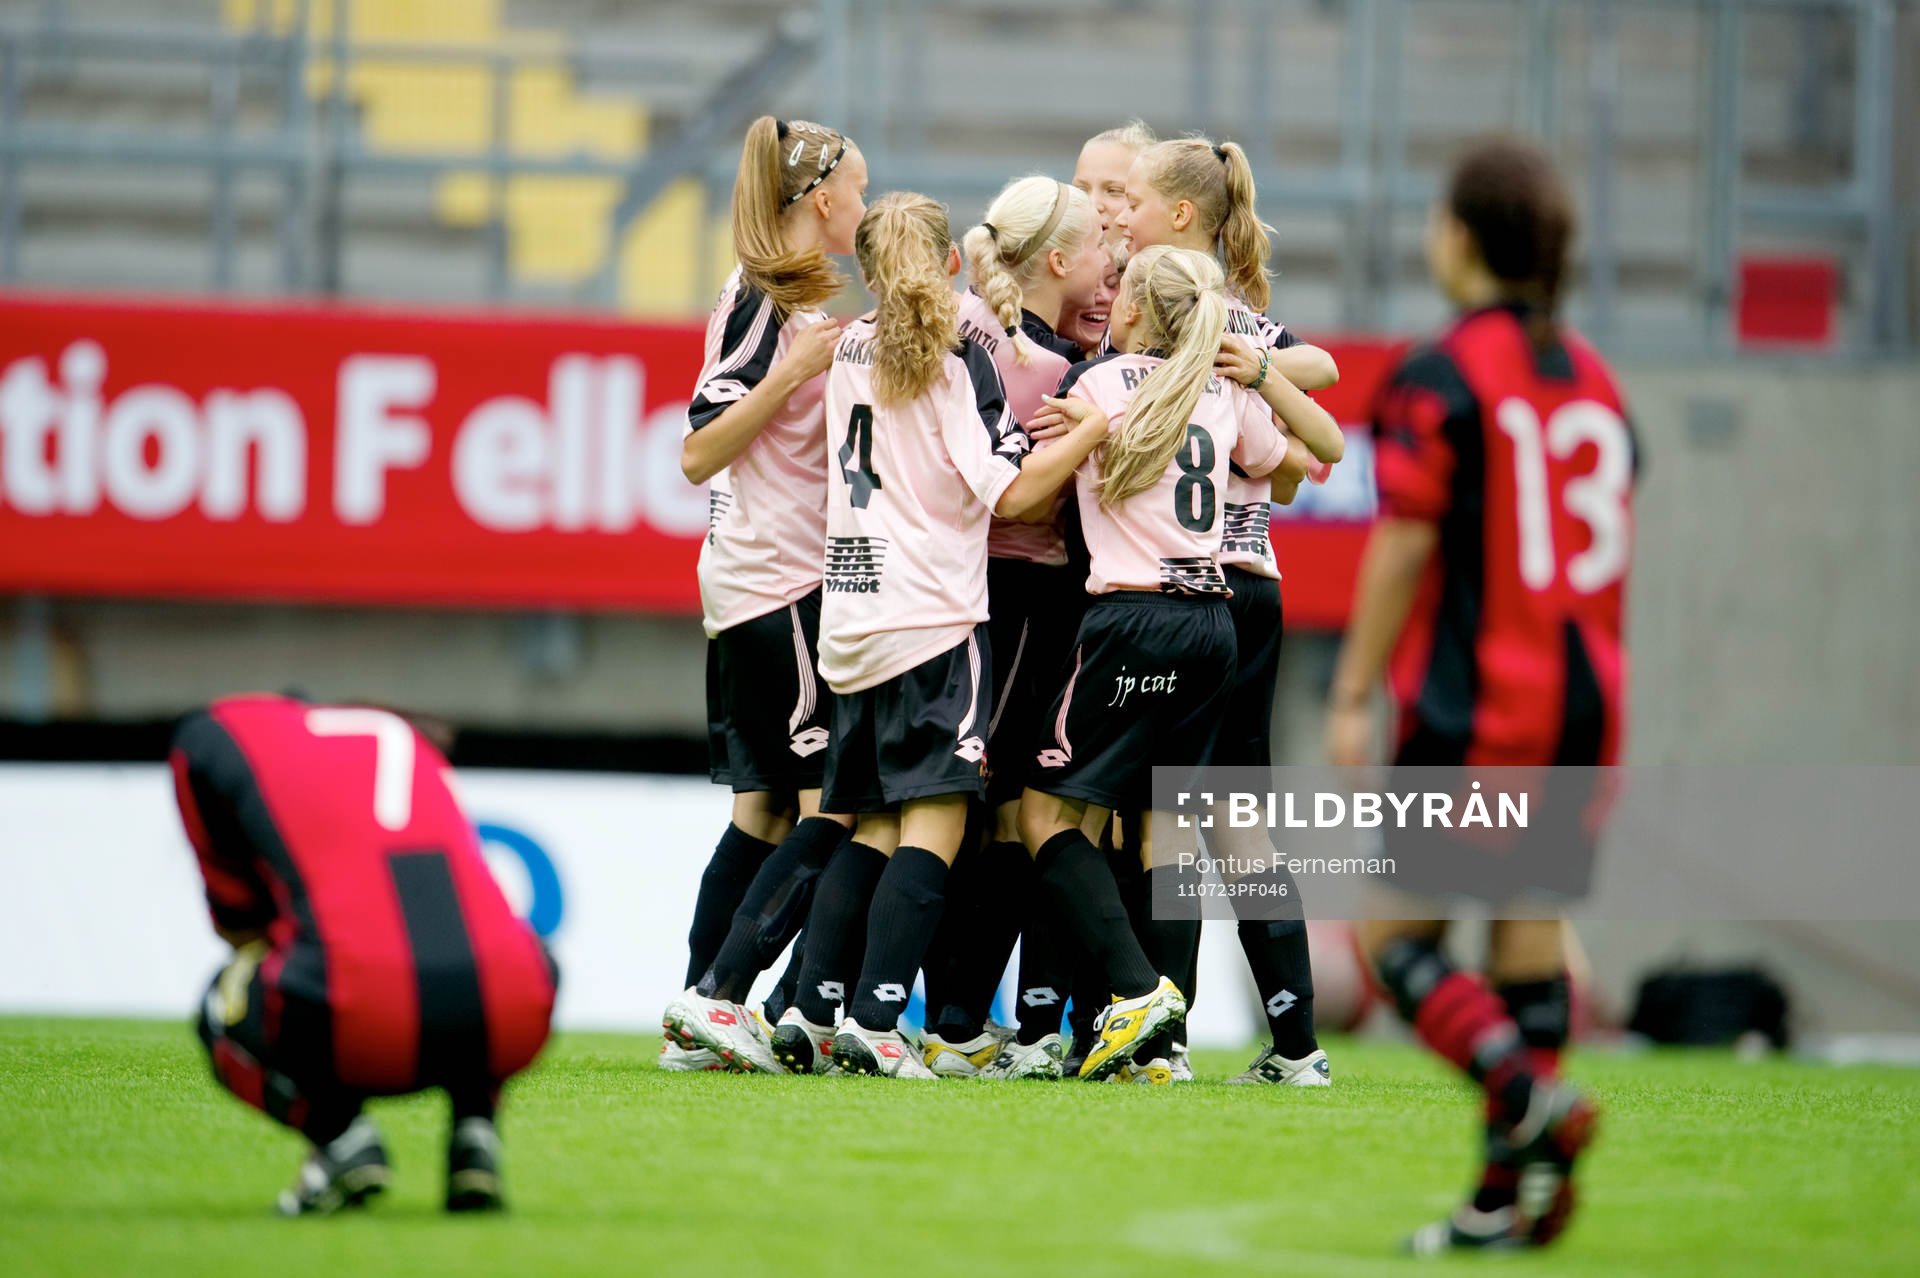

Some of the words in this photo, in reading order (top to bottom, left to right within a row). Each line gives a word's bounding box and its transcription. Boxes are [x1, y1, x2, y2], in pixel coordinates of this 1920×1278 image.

[333, 353, 437, 527] F
[838, 403, 883, 510] 4
[1174, 423, 1217, 534] 8
[1496, 396, 1634, 596] 13
[1108, 665, 1136, 707] jp
[304, 707, 416, 832] 7
